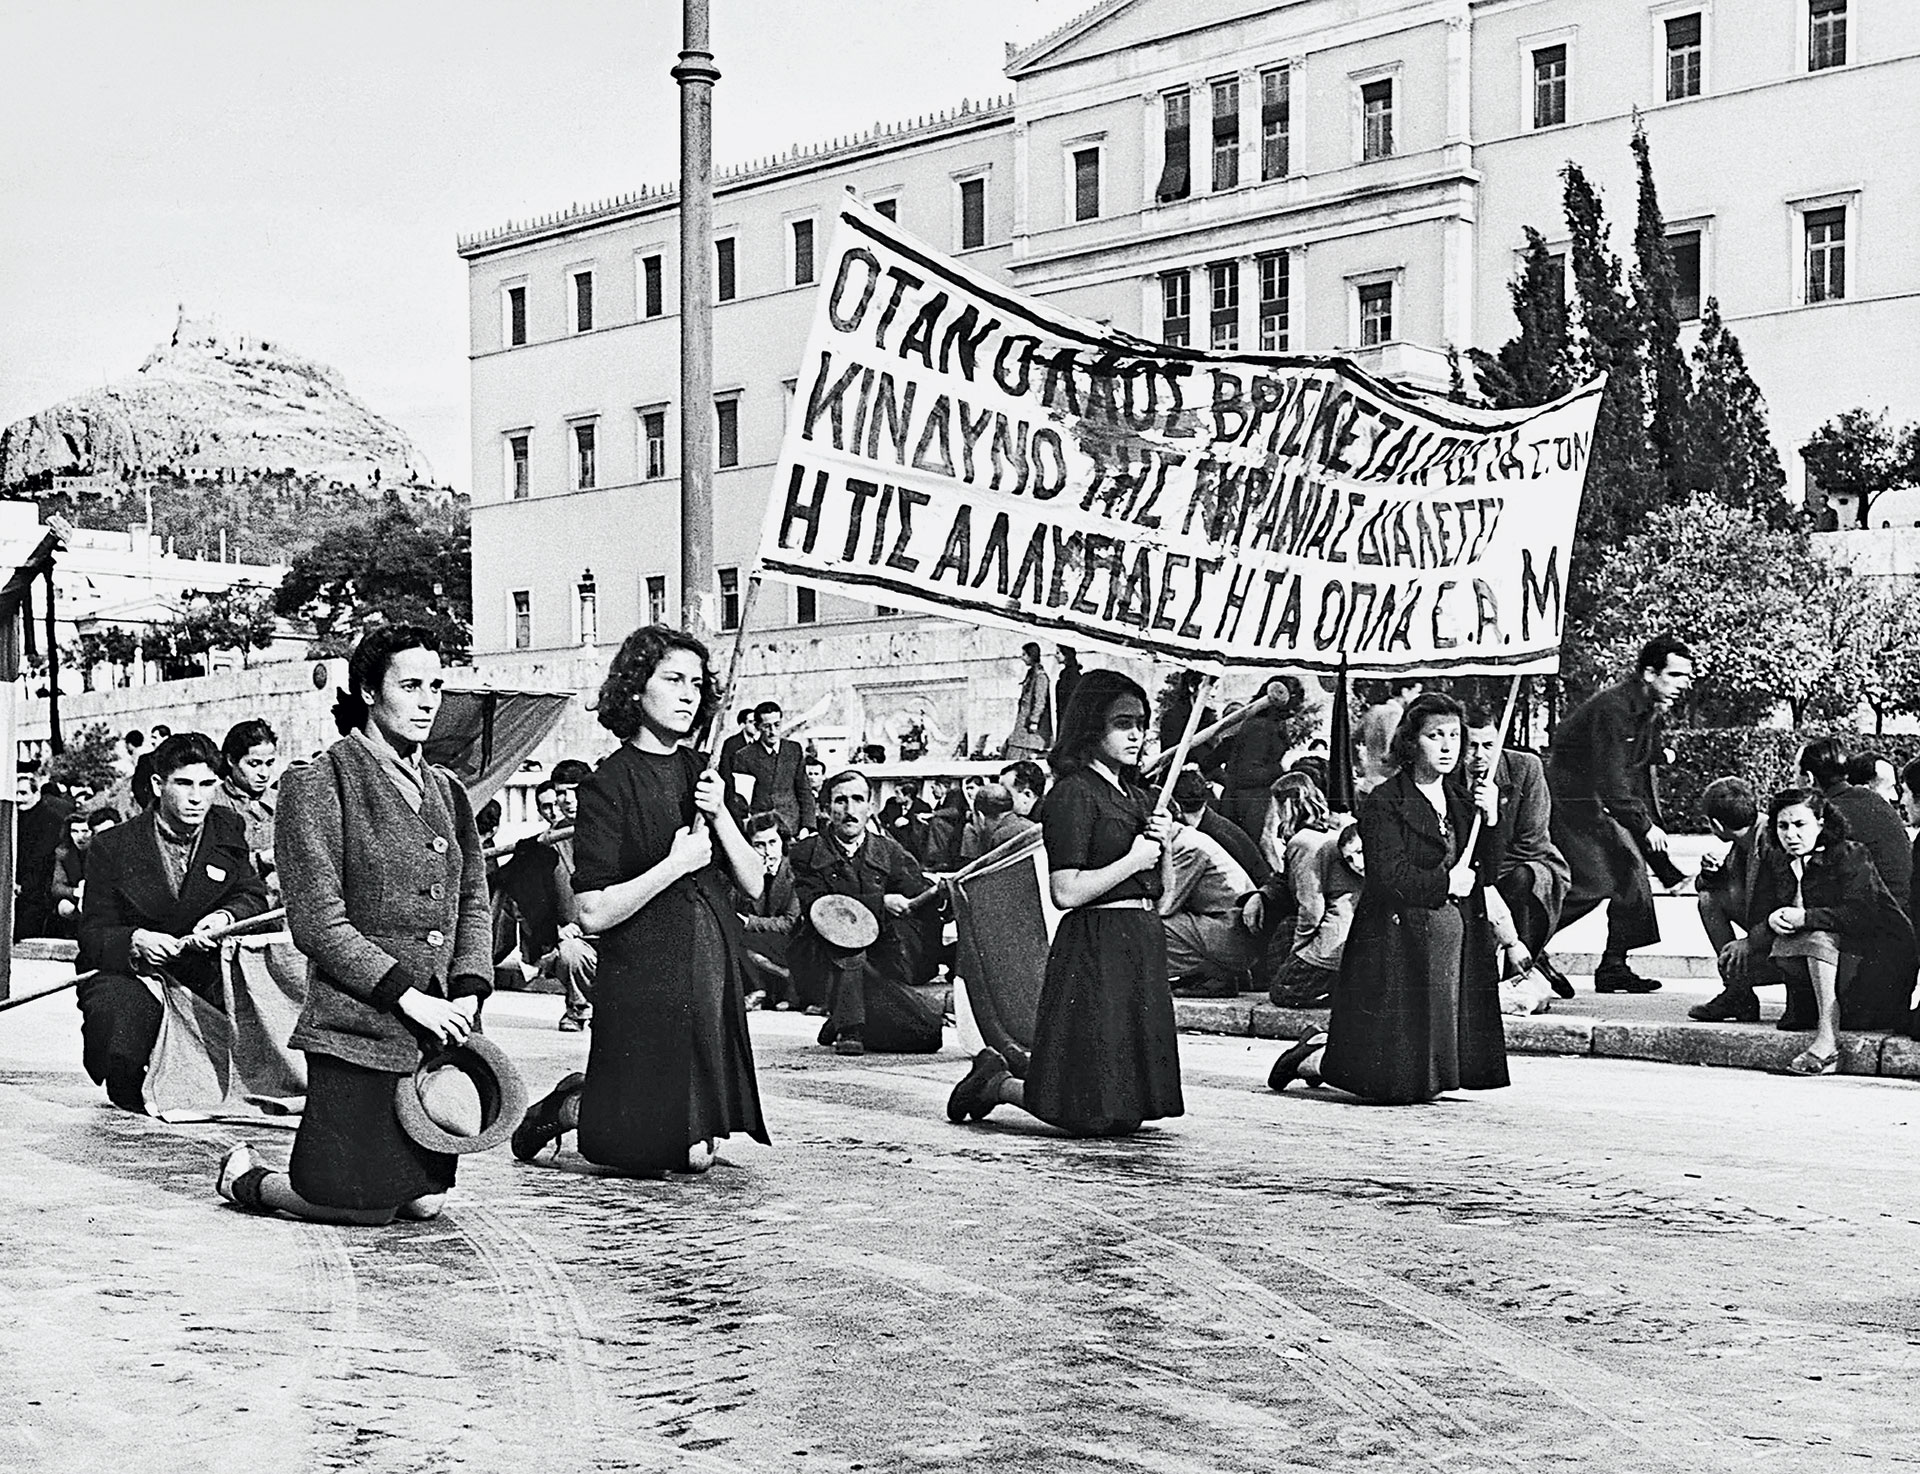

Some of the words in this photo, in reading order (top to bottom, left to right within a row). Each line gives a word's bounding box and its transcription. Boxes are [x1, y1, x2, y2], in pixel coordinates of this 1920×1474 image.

[829, 246, 1001, 383] ΟΤΑΝ
[993, 334, 1043, 397] Ο
[801, 350, 1067, 500] ΚΙΝΔΥΝΟ
[778, 463, 830, 554] Η
[841, 477, 932, 573] ΤΙΣ
[1213, 563, 1256, 643] Η
[1253, 567, 1301, 650] ΤΑ
[1313, 577, 1422, 654] ΟΠΛΑ
